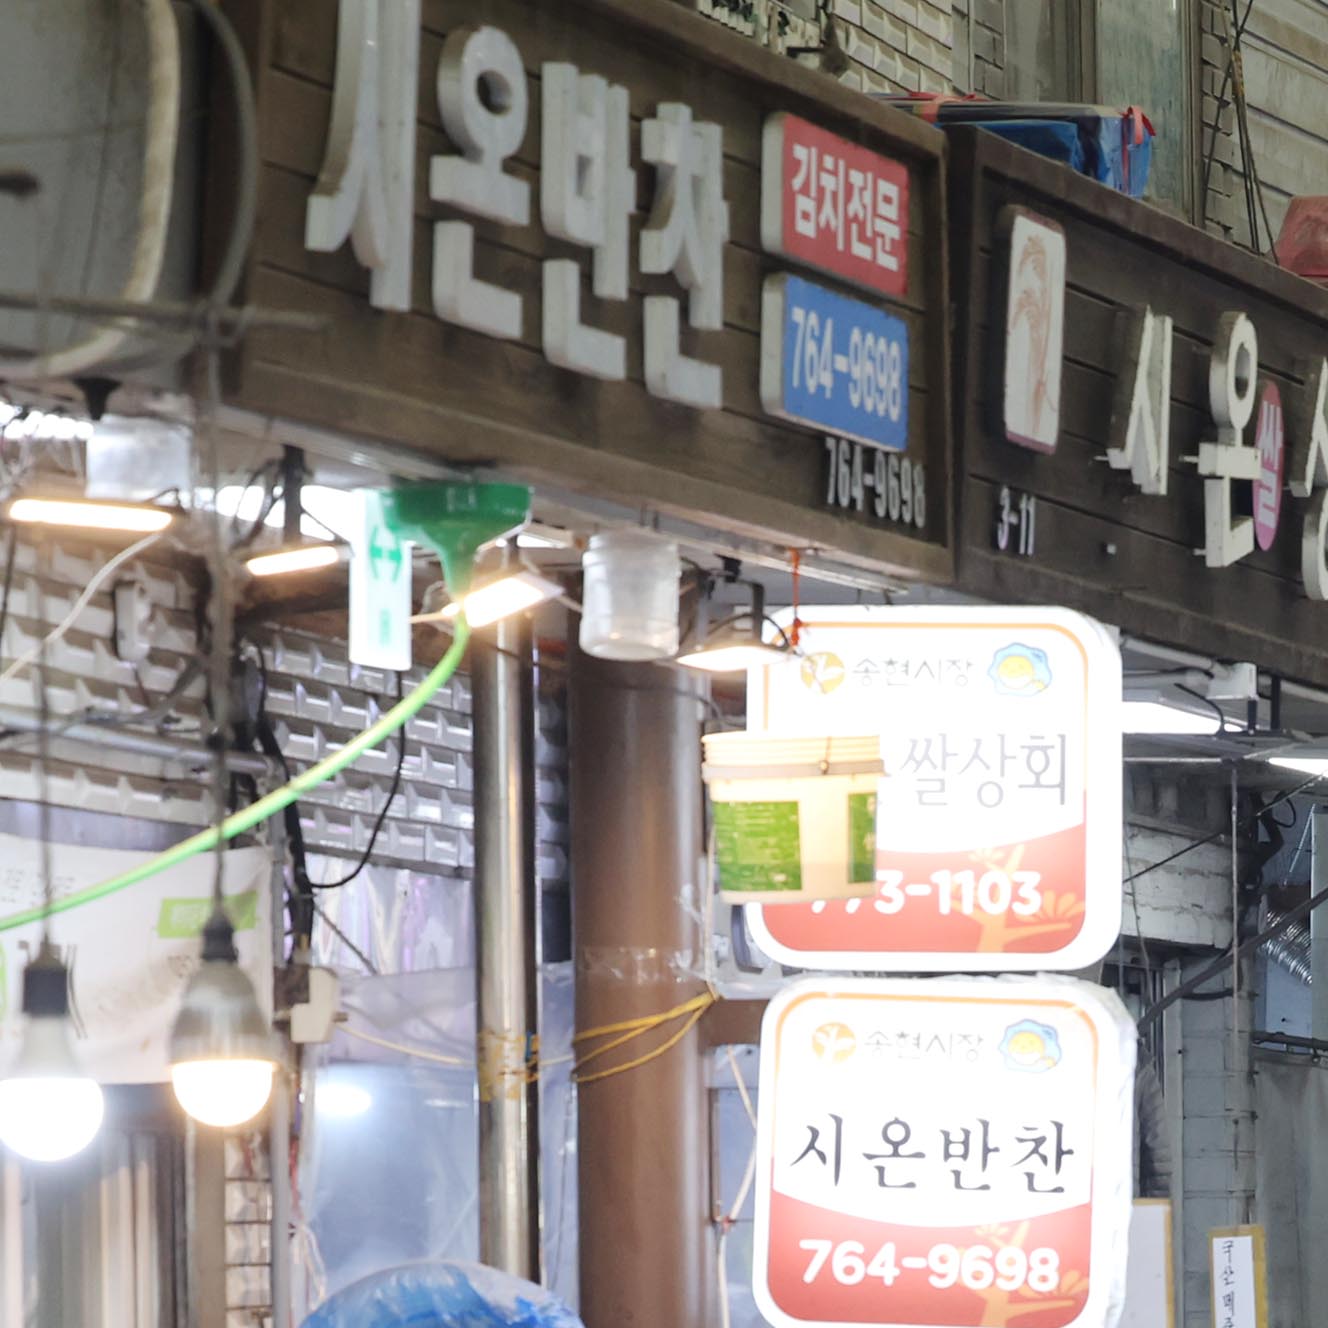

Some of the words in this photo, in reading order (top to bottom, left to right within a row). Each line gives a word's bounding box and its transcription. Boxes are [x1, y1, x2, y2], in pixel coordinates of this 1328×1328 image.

[305, 0, 728, 410] 시온반찬
[791, 143, 900, 272] 김치전문
[791, 306, 900, 422] 764-9698
[826, 436, 926, 528] 764-9698
[853, 657, 975, 687] 송현시장
[812, 869, 1042, 915] 3-1103
[864, 1024, 984, 1063] 송현시장
[790, 1113, 1075, 1194] 시온반찬
[799, 1239, 1060, 1293] 764-9698
